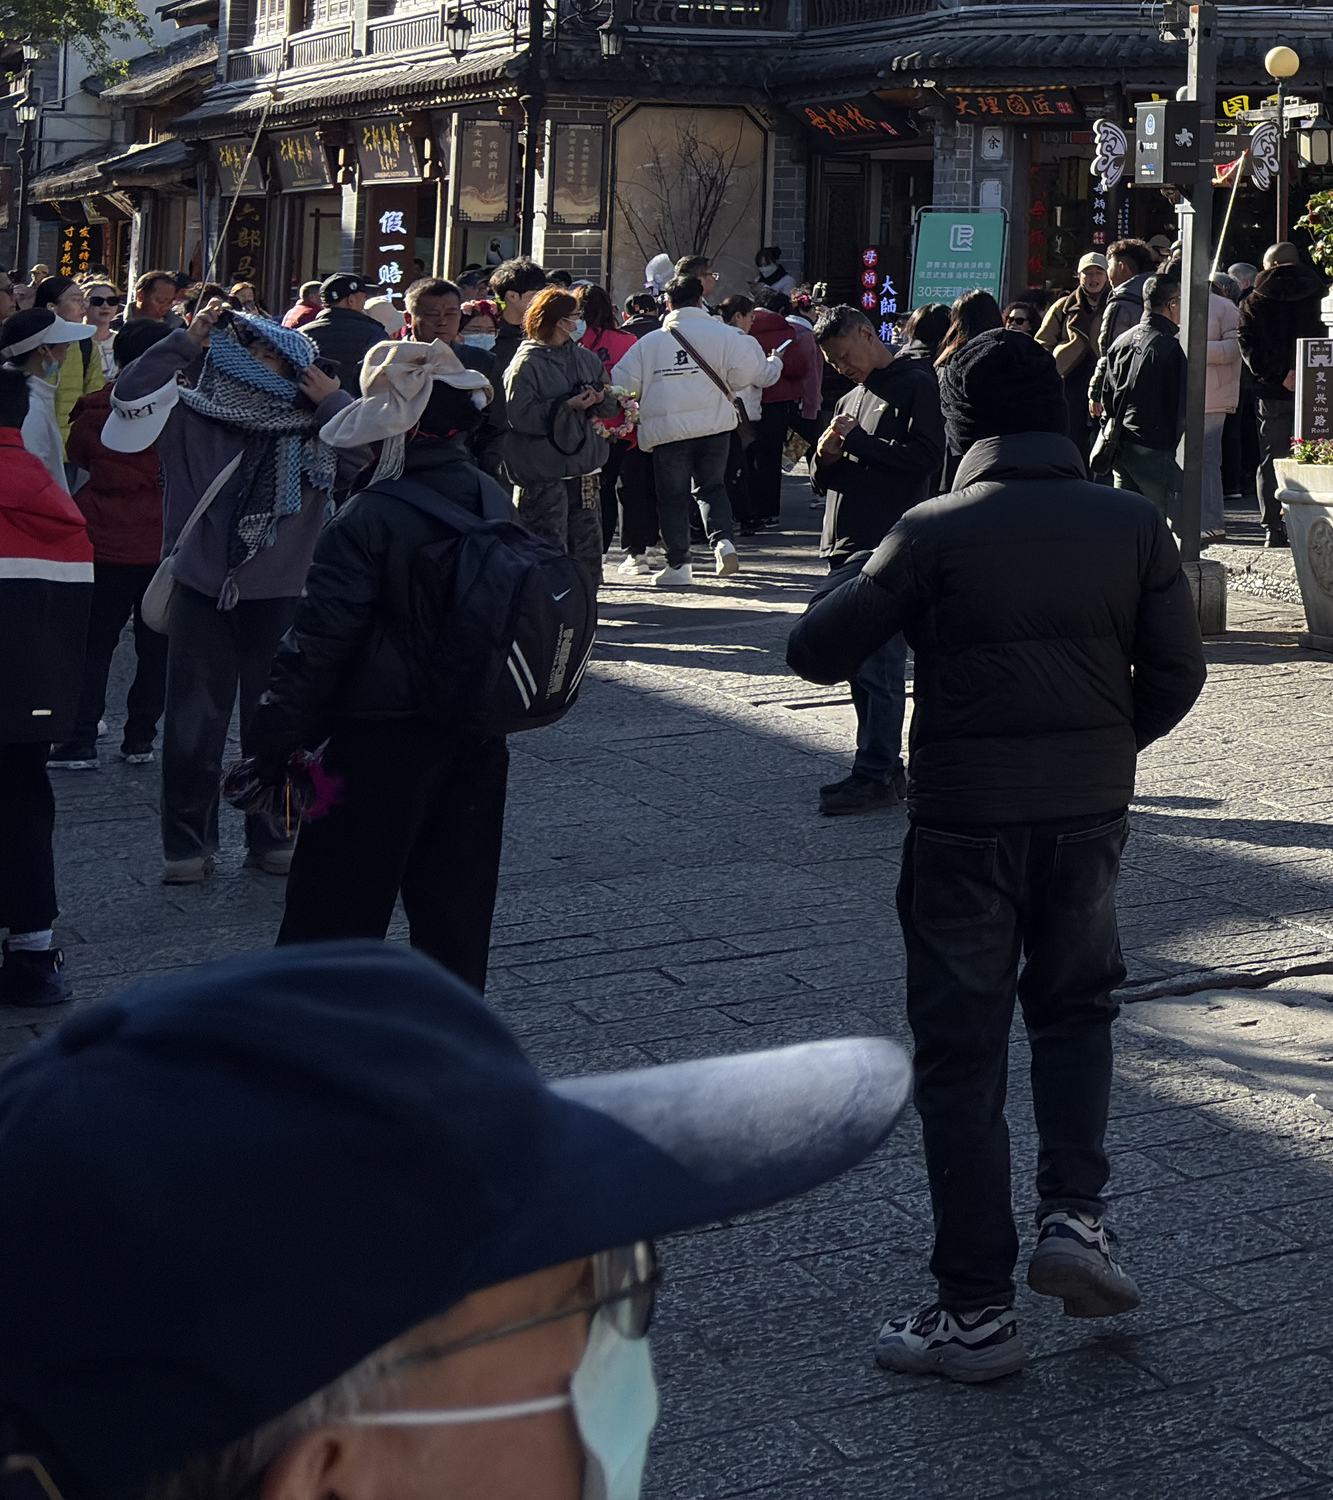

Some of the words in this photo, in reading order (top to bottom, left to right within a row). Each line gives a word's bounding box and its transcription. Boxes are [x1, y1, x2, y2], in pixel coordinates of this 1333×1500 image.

[987, 135, 1001, 150] 余
[862, 250, 878, 308] 母炳林
[1315, 371, 1327, 383] 复
[1314, 393, 1327, 404] 兴
[1313, 414, 1327, 427] 路
